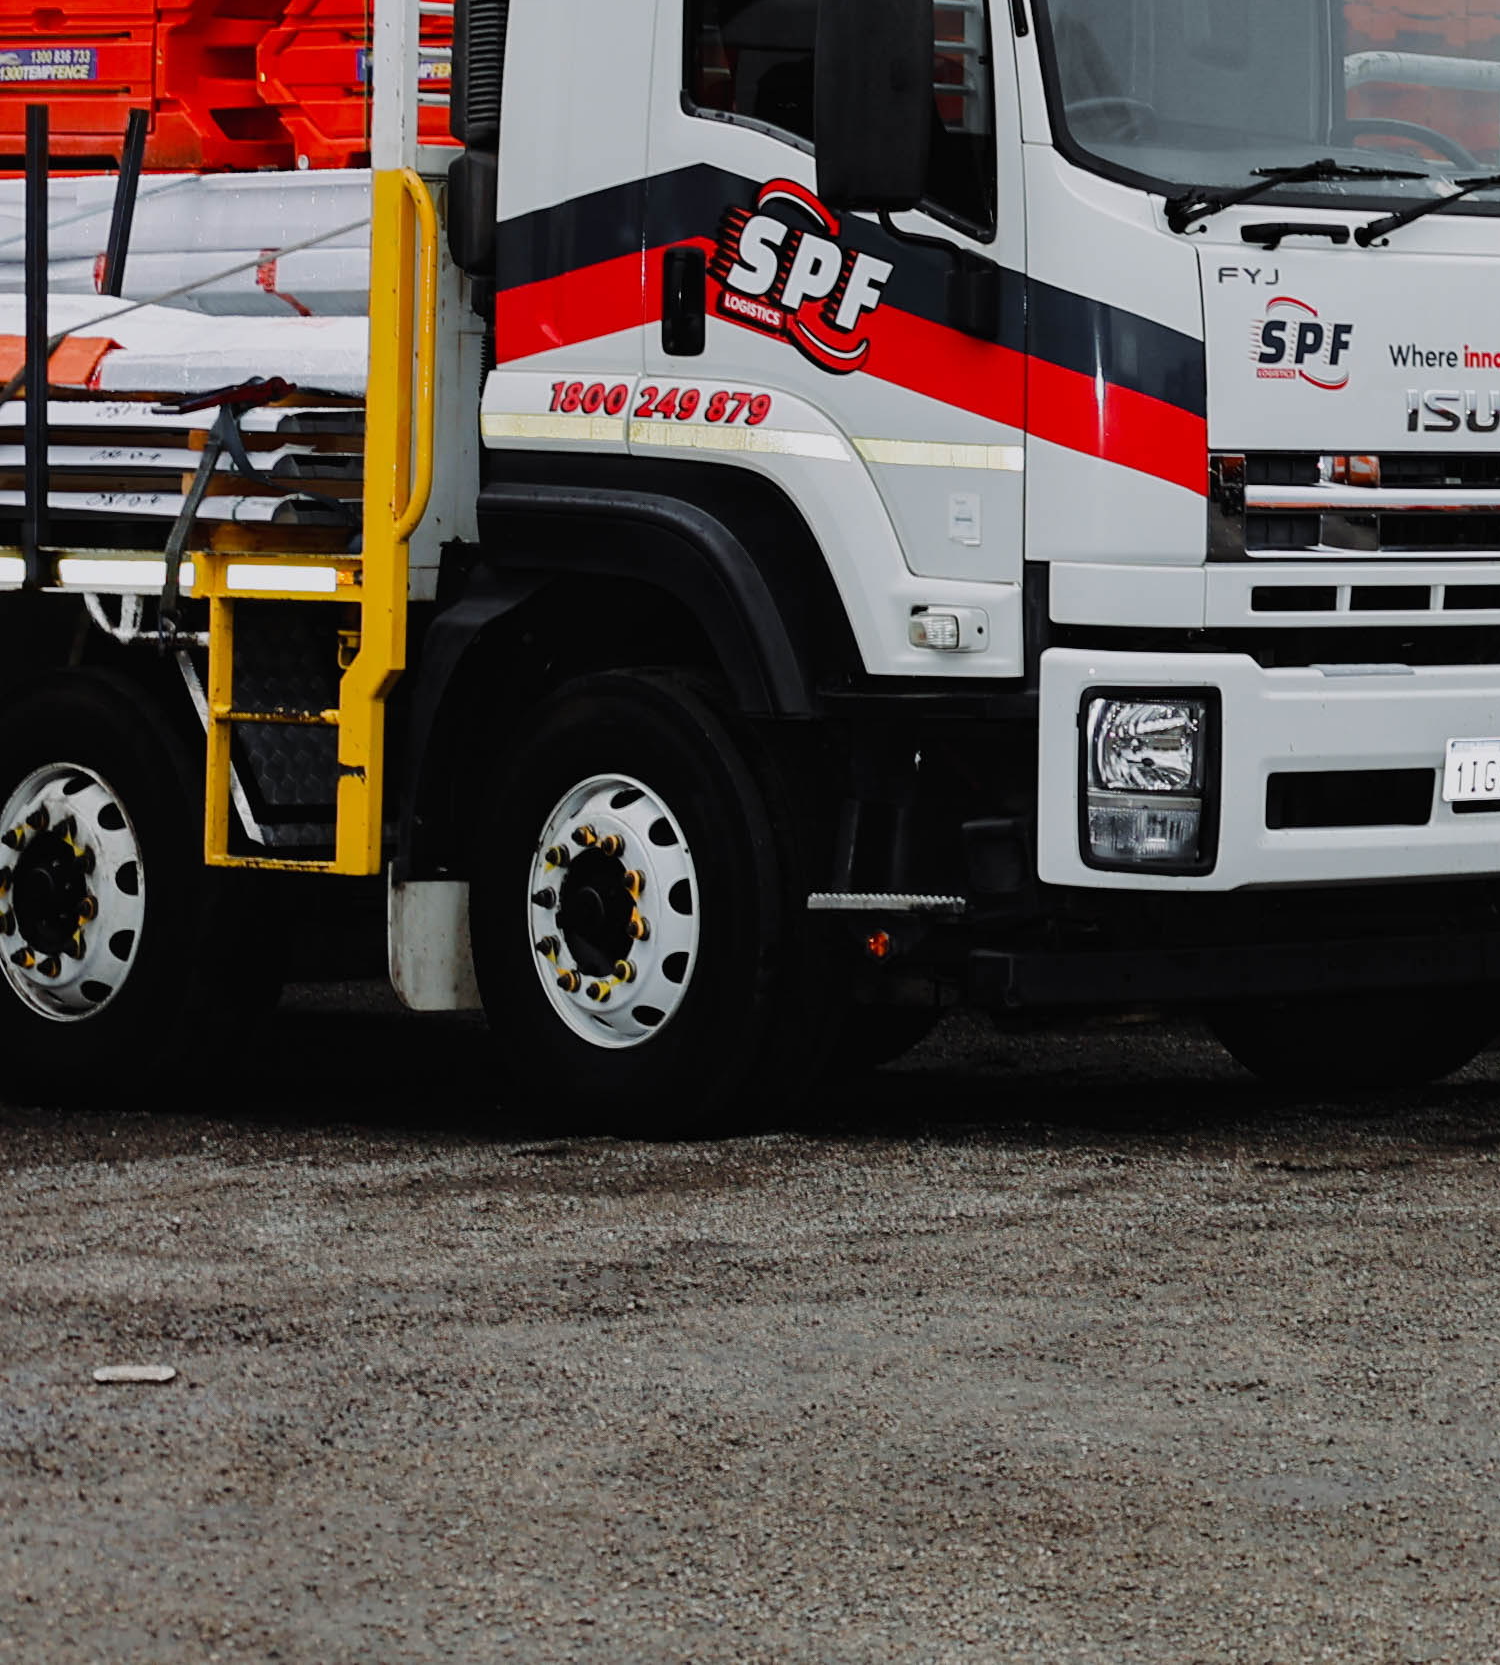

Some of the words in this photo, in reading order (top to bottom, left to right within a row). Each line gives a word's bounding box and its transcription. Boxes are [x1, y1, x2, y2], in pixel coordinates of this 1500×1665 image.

[727, 215, 895, 331] SPF
[1218, 267, 1280, 285] FYJ
[724, 293, 782, 326] LOGISTICS
[1258, 320, 1353, 366] SPF
[1389, 344, 1458, 368] Where
[1257, 369, 1296, 379] LOGISTICS
[549, 380, 629, 416] 1800
[634, 386, 701, 421] 249
[705, 390, 772, 426] 879
